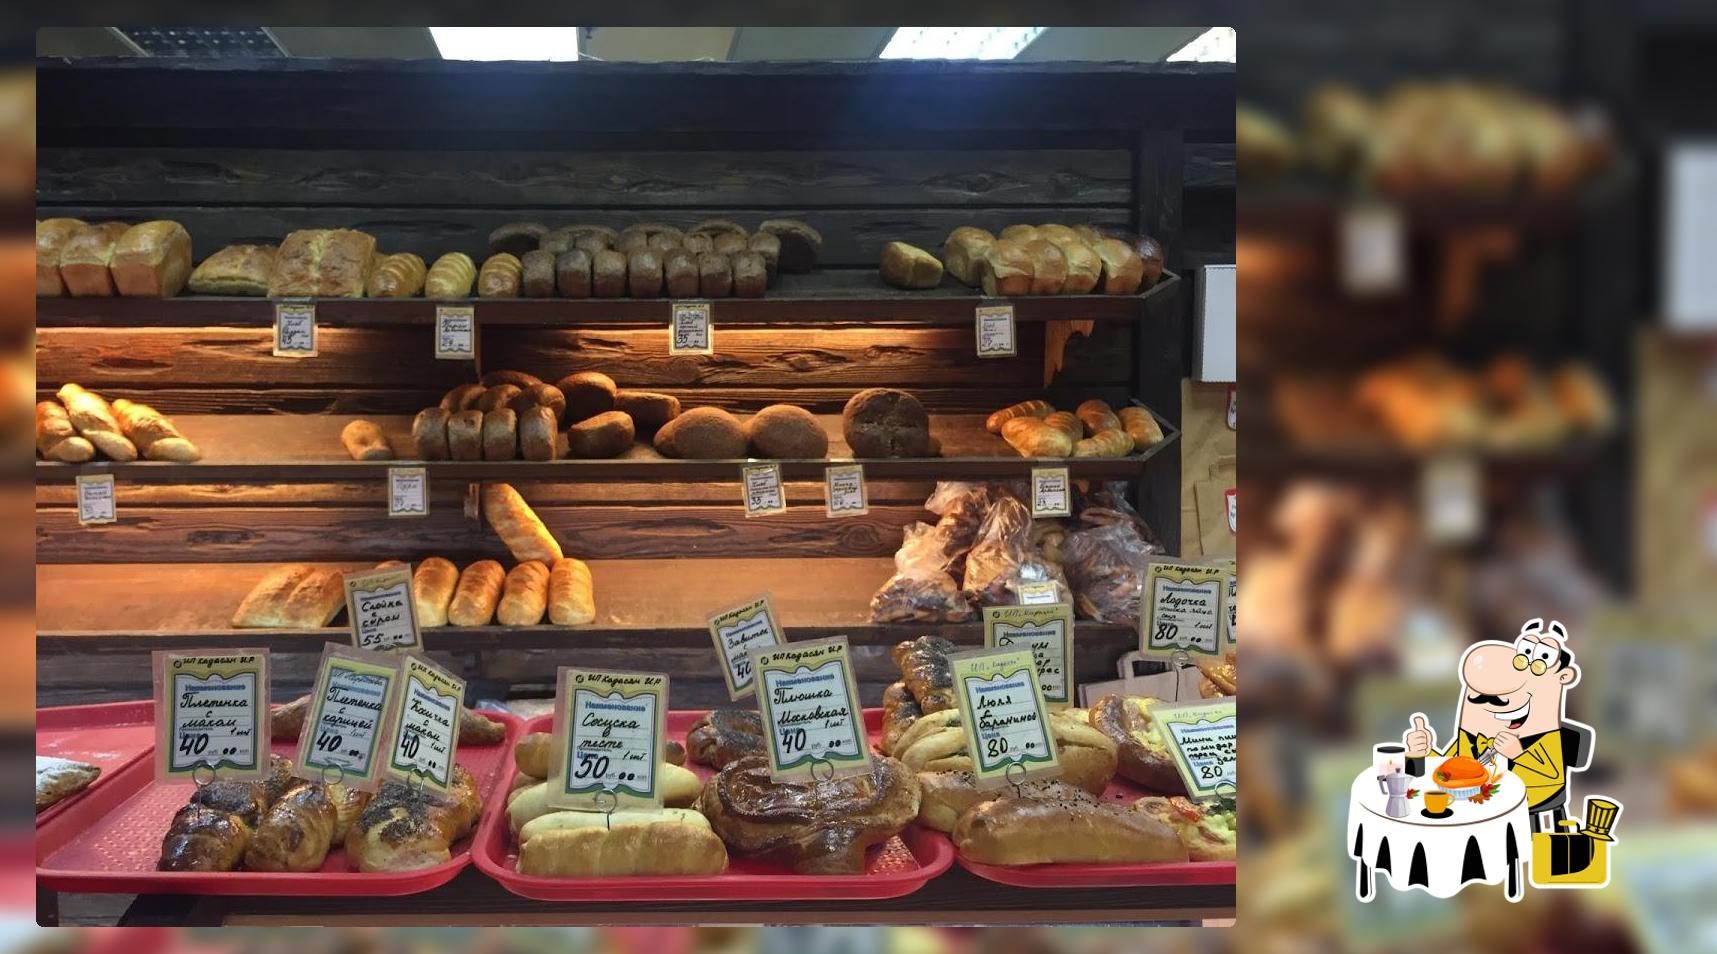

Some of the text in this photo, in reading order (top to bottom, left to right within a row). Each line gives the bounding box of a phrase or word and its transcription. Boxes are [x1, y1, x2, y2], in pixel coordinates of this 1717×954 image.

[361, 600, 404, 613] Слойка
[1160, 592, 1207, 608] Лодочка
[362, 614, 400, 627] сыром
[361, 633, 384, 647] 55
[728, 628, 769, 650] Завиток
[1154, 624, 1178, 640] 80
[180, 692, 249, 708] Плетенка
[327, 686, 384, 711] Плетенка
[773, 687, 832, 705] Плюшка
[977, 695, 1012, 710] Люля
[206, 710, 213, 719] с
[339, 707, 346, 715] с
[410, 698, 450, 727] Косичка
[584, 701, 646, 712] Наименование
[777, 705, 849, 725] Московская
[979, 712, 1037, 731] бараниной
[183, 719, 237, 728] маком
[405, 723, 440, 742] маком
[1180, 736, 1213, 745] Мини
[179, 733, 209, 755] 40
[316, 731, 343, 752] 40
[400, 731, 420, 759] 40
[579, 739, 624, 749] тесте
[782, 728, 807, 754] 40
[987, 737, 1009, 758] 80
[574, 755, 610, 779] 50
[618, 771, 635, 780] 00
[1201, 766, 1223, 779] 80
